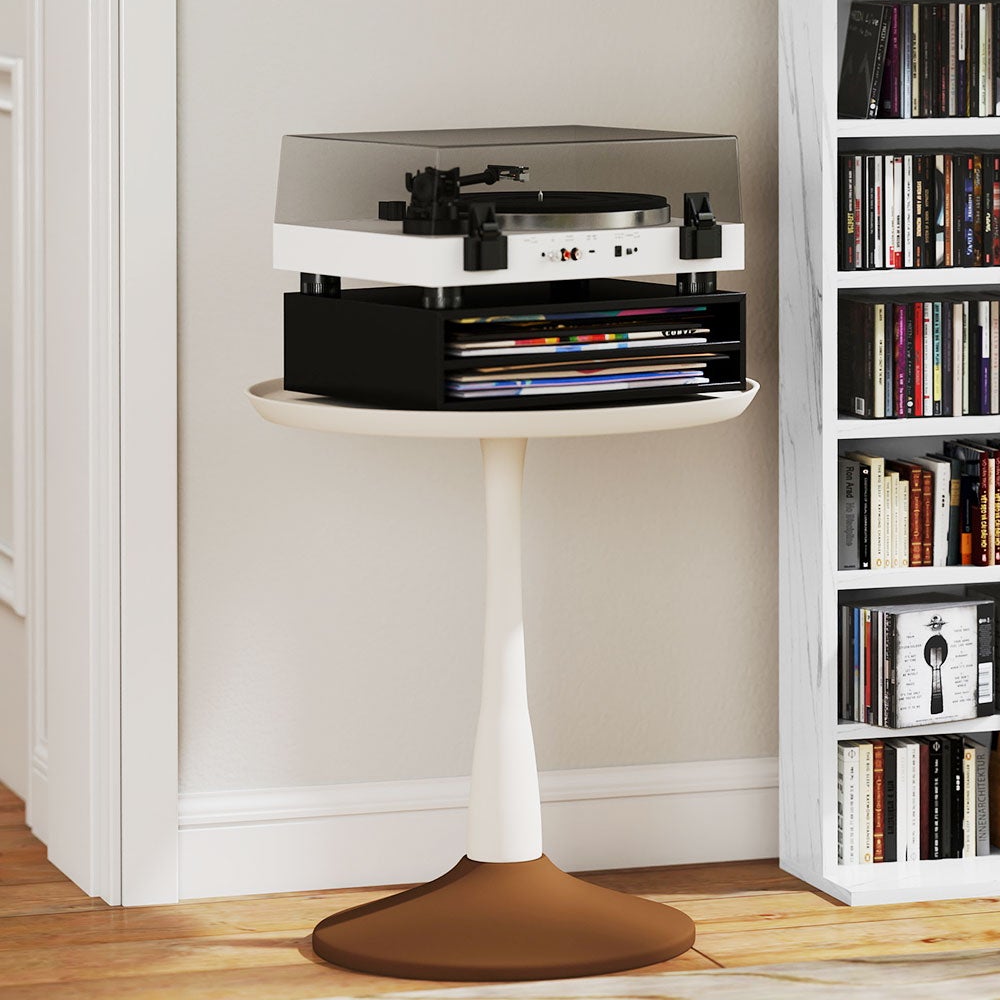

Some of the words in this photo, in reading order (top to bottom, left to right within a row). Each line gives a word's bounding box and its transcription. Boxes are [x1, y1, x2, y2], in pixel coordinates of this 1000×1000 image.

[846, 466, 854, 480] Ron
[846, 482, 854, 498] Arad
[977, 754, 987, 842] INNENARCHITEKTUR
